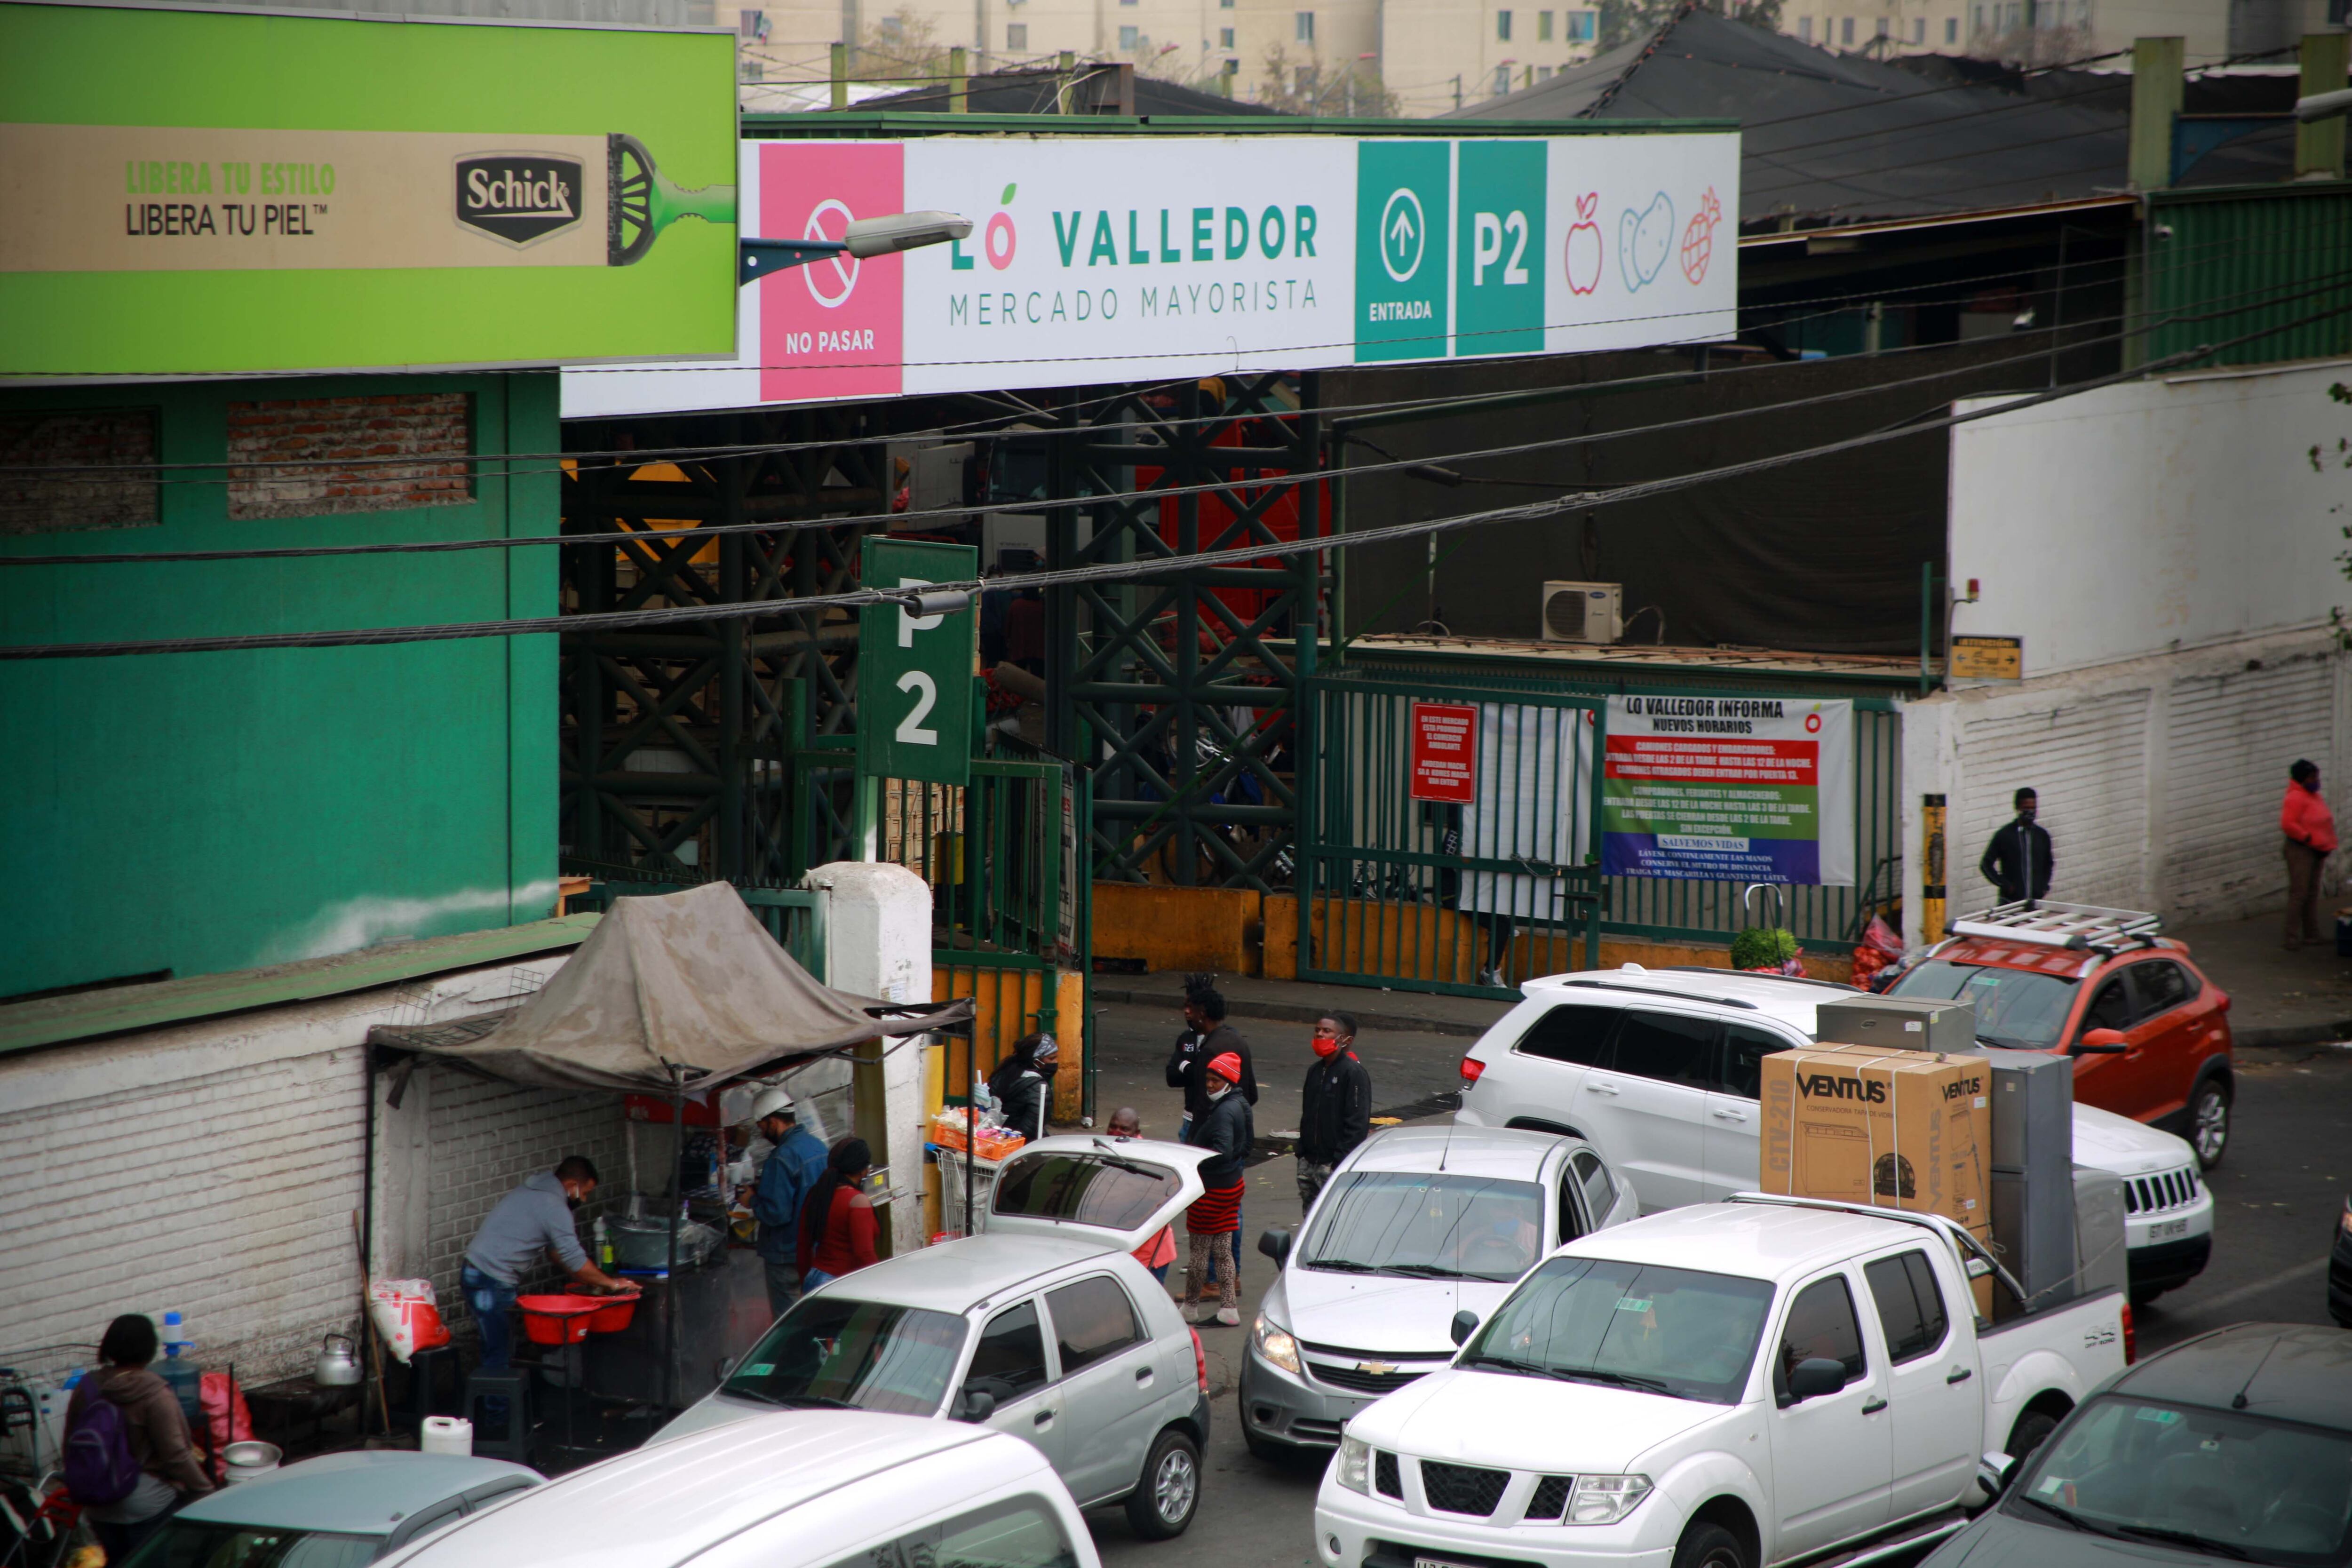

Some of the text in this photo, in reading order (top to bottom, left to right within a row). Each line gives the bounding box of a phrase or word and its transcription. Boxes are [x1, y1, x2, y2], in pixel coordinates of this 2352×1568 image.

[126, 160, 335, 196] LIBERA TU ESTILO
[126, 203, 217, 236] LIBERA
[222, 204, 256, 236] TU
[1052, 204, 1317, 268] VALLEDOR
[1473, 210, 1529, 287] P2
[950, 279, 1317, 326] MERCADO MAYORISTA
[1369, 301, 1432, 322] ENTRADA
[786, 329, 874, 355] NO PASAR
[898, 577, 945, 648] P
[896, 670, 938, 746] 2
[1627, 697, 1784, 719] LO VALLEDOR INFORMA
[1653, 718, 1753, 734] NUEVOS HORARIOS
[1636, 742, 1673, 752] CAMIONES
[1673, 743, 1711, 753] CARGADOS
[1712, 744, 1717, 753] Y
[1655, 754, 1669, 764] LAS
[1669, 755, 1675, 764] 2
[1676, 756, 1685, 764] DE
[1685, 756, 1694, 764] LA
[1718, 756, 1742, 766] HASTA
[1742, 757, 1756, 767] LAS
[1756, 757, 1765, 767] 12
[1766, 758, 1775, 767] DE
[1776, 758, 1785, 767] LA
[1657, 799, 1670, 808] LAS
[1671, 800, 1679, 809] 12
[1680, 800, 1689, 809] DE
[1690, 800, 1699, 809] LA
[1747, 802, 1761, 812] LAS
[1768, 803, 1778, 812] DE
[1778, 803, 1786, 812] LA
[1722, 789, 1727, 798] Y
[1621, 809, 1635, 819] LAS
[1666, 811, 1675, 820] SE
[1730, 814, 1743, 823] LAS
[1743, 814, 1749, 823] 2
[1750, 815, 1760, 824] DE
[1760, 815, 1769, 824] LA
[1680, 824, 1692, 833] SIN
[1663, 838, 1744, 849] SALVEMOS VIDAS
[1796, 1072, 1886, 1104] VENTUS
[1941, 1076, 1980, 1103] VENTUS
[1806, 1104, 1852, 1114] CONSERVADORA
[1768, 1079, 1790, 1172] CTV-210
[1930, 1108, 1943, 1212] VENTUS
